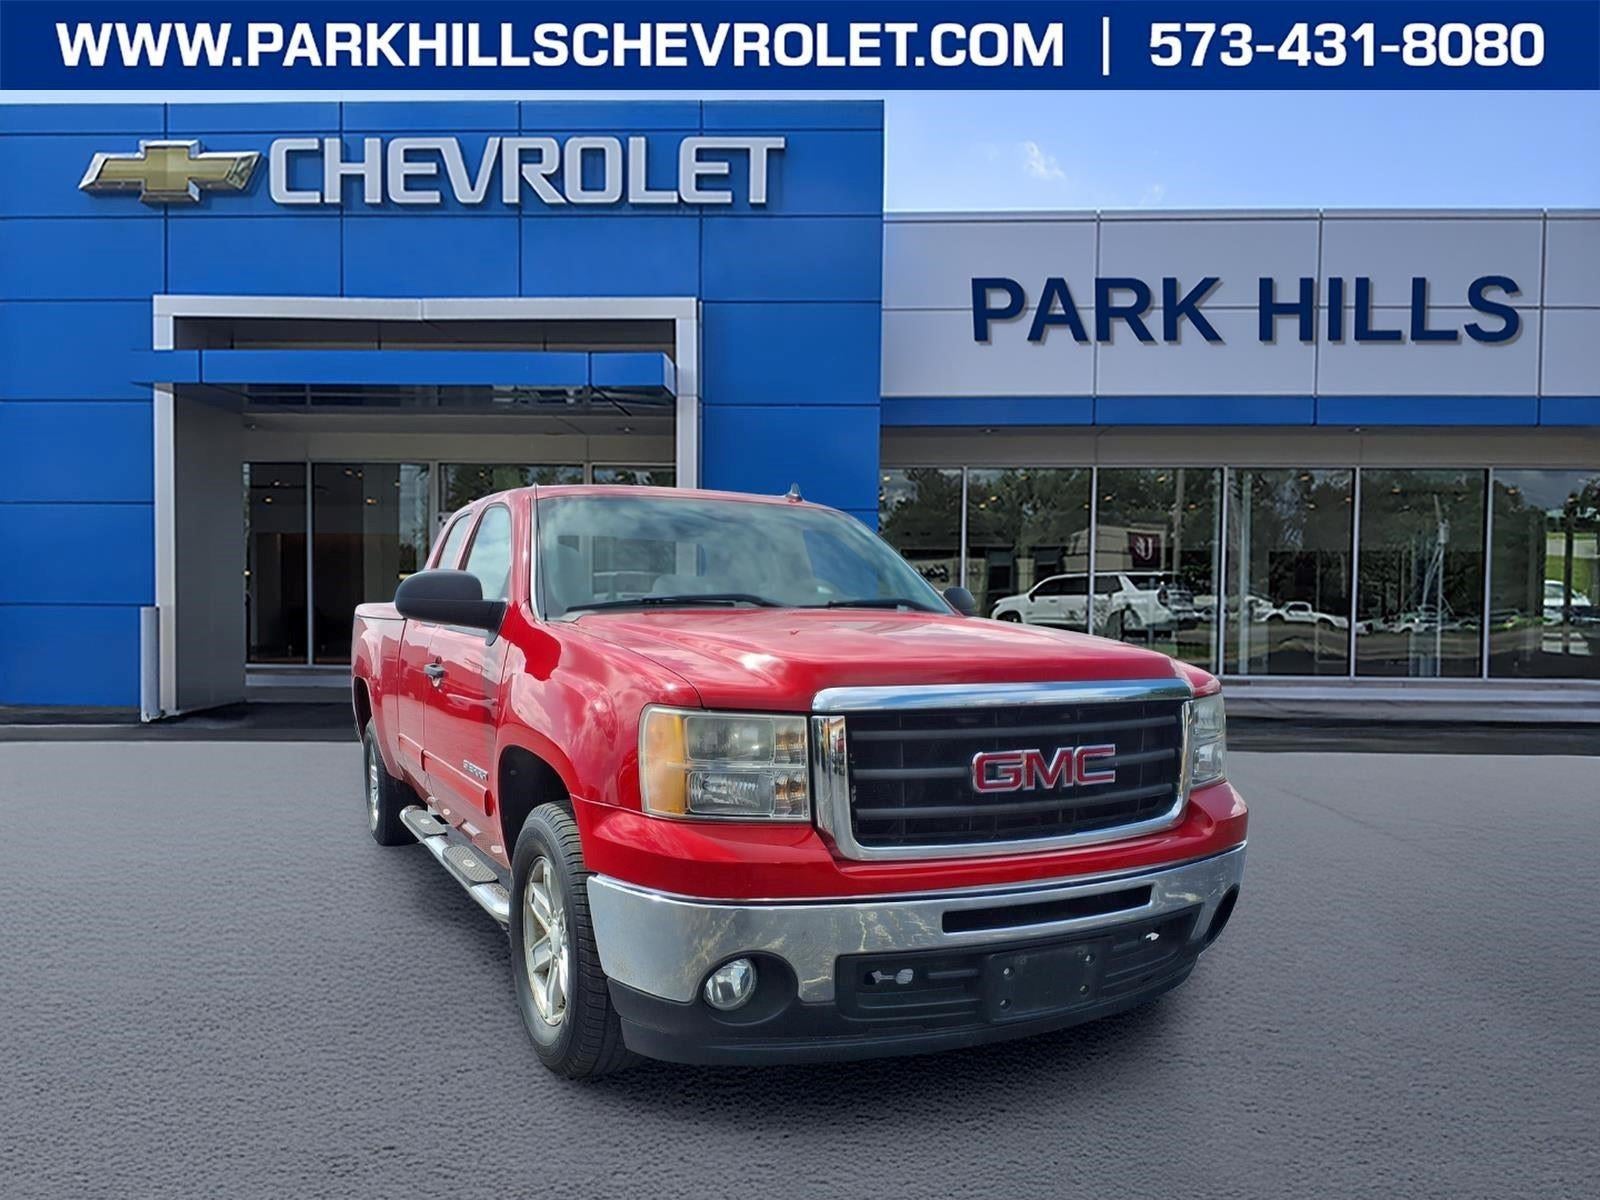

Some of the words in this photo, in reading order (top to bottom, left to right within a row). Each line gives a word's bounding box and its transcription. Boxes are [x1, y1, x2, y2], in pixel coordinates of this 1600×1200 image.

[269, 136, 786, 204] CHEVROLET
[971, 277, 1222, 343] PARK
[1258, 275, 1521, 343] HILLS
[971, 743, 1117, 794] GMC
